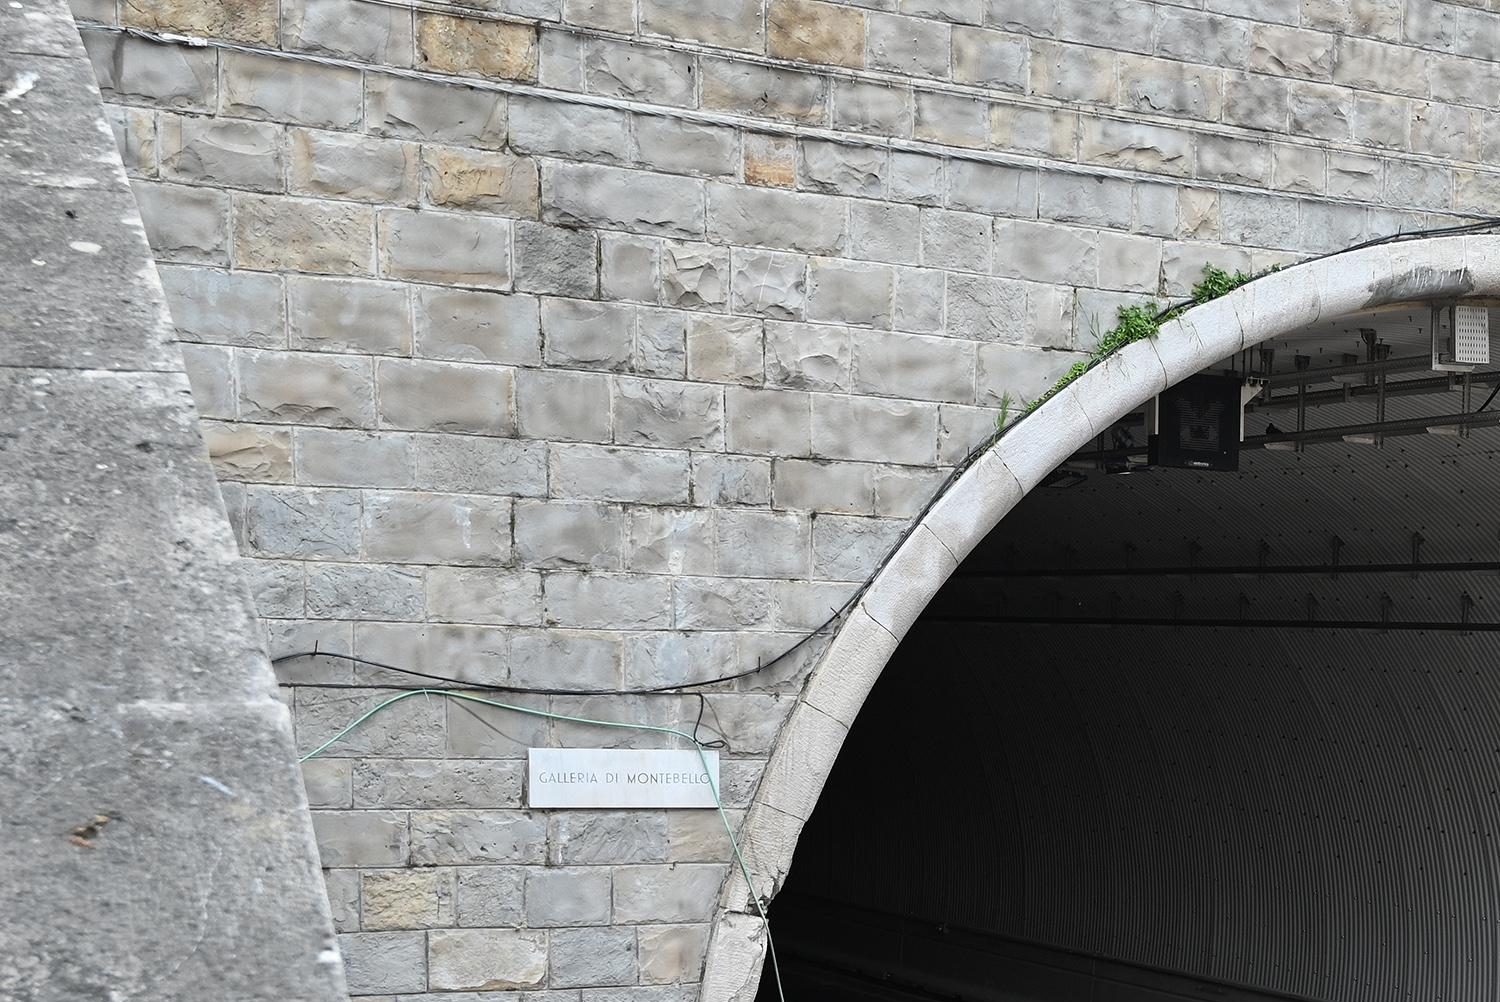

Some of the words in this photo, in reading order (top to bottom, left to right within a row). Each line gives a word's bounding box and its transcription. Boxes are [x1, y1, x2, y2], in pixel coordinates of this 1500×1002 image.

[539, 771, 598, 784] GALLERIA
[606, 771, 618, 784] DI
[627, 771, 711, 784] MONTEBELLO
